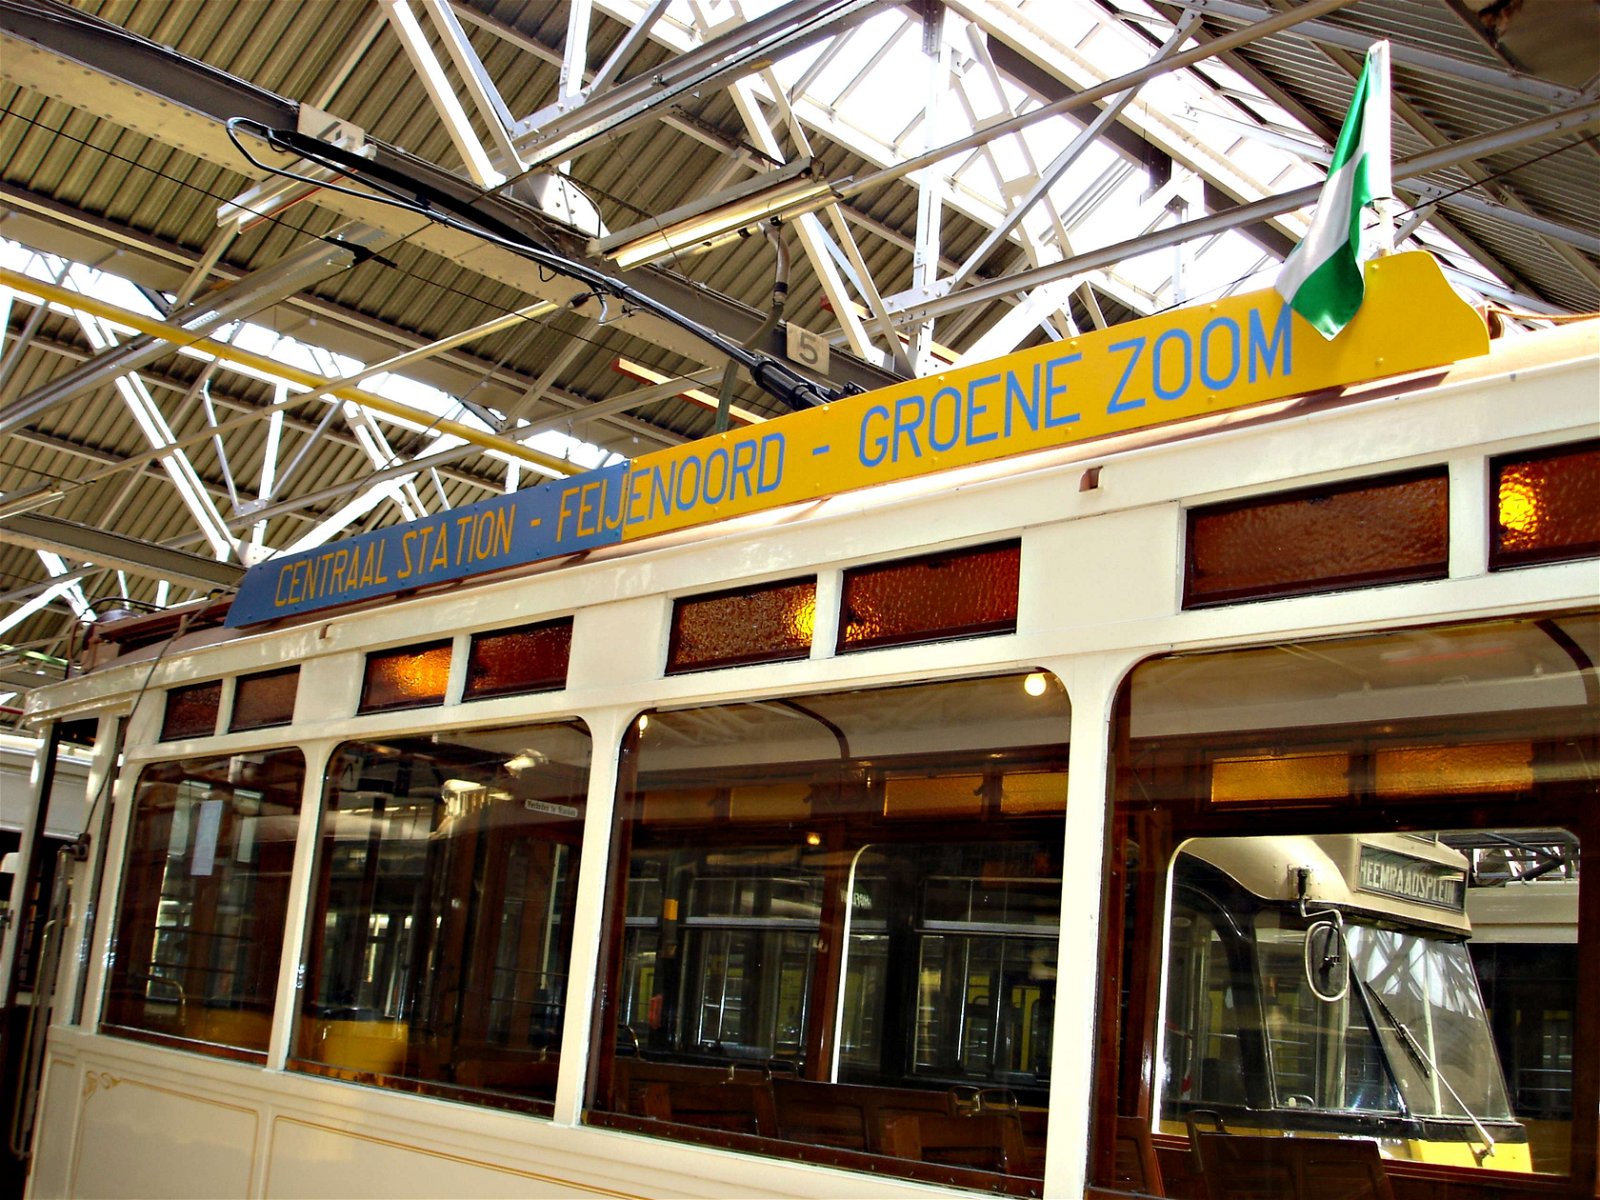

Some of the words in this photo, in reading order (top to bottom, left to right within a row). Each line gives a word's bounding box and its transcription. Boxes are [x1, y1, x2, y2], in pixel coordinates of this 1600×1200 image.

[799, 332, 819, 365] 5
[274, 539, 389, 608] CENTRAAL
[397, 503, 517, 579] STATION
[555, 431, 786, 543] FEIJENOORD
[858, 352, 1083, 468] GROENE
[1106, 305, 1293, 416] ZOOM
[1360, 858, 1456, 905] HEEMRAADSPLEIN
